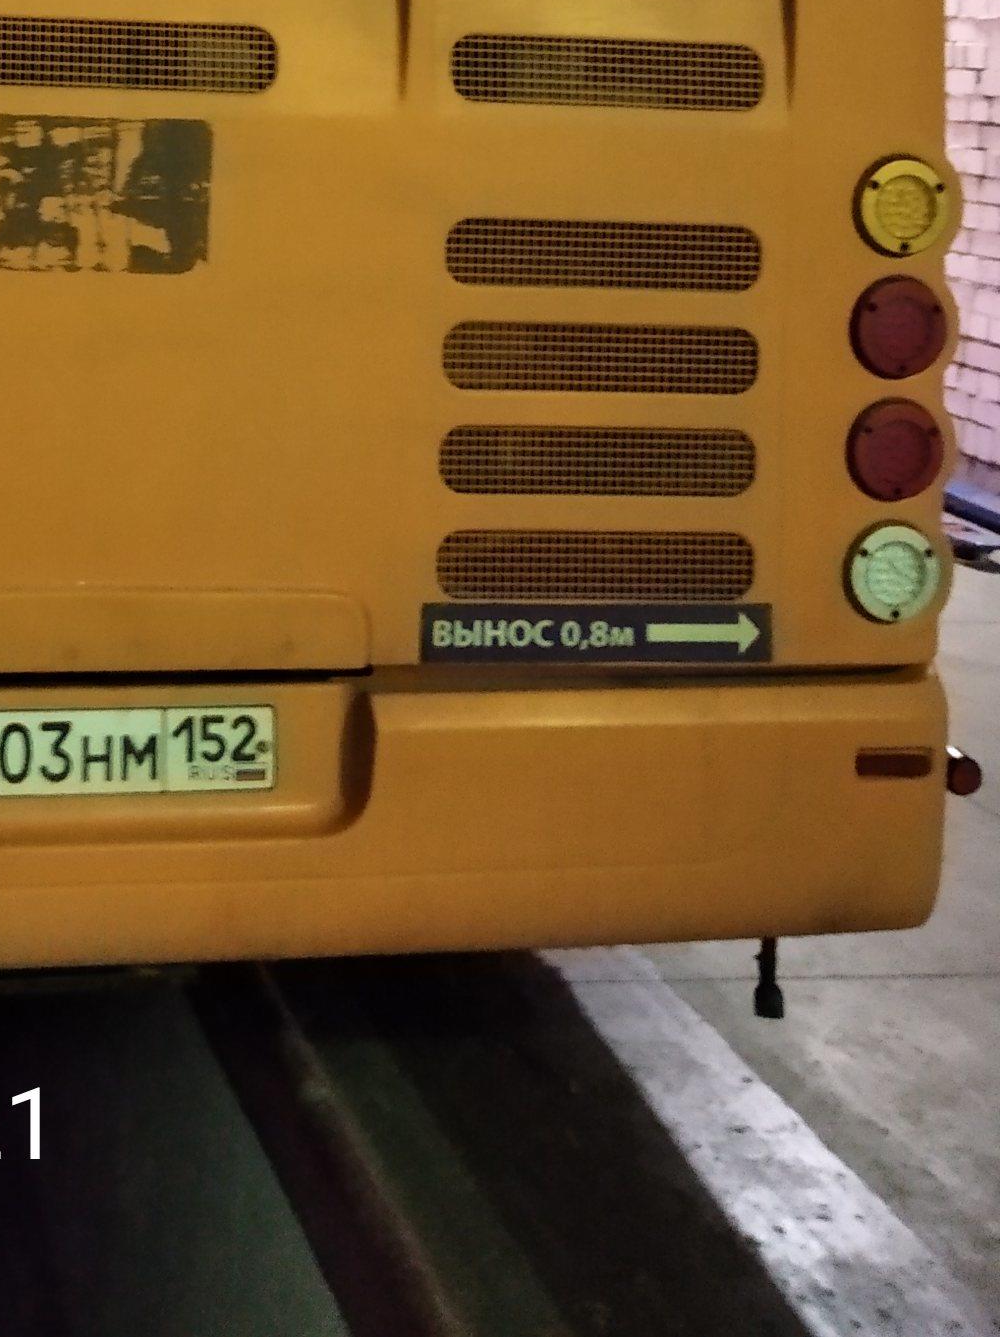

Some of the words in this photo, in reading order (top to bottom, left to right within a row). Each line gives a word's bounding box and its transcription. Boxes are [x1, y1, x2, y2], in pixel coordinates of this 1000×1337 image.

[432, 619, 555, 648] ВЫНОС
[560, 620, 635, 650] 0,8м
[171, 714, 258, 763] 152
